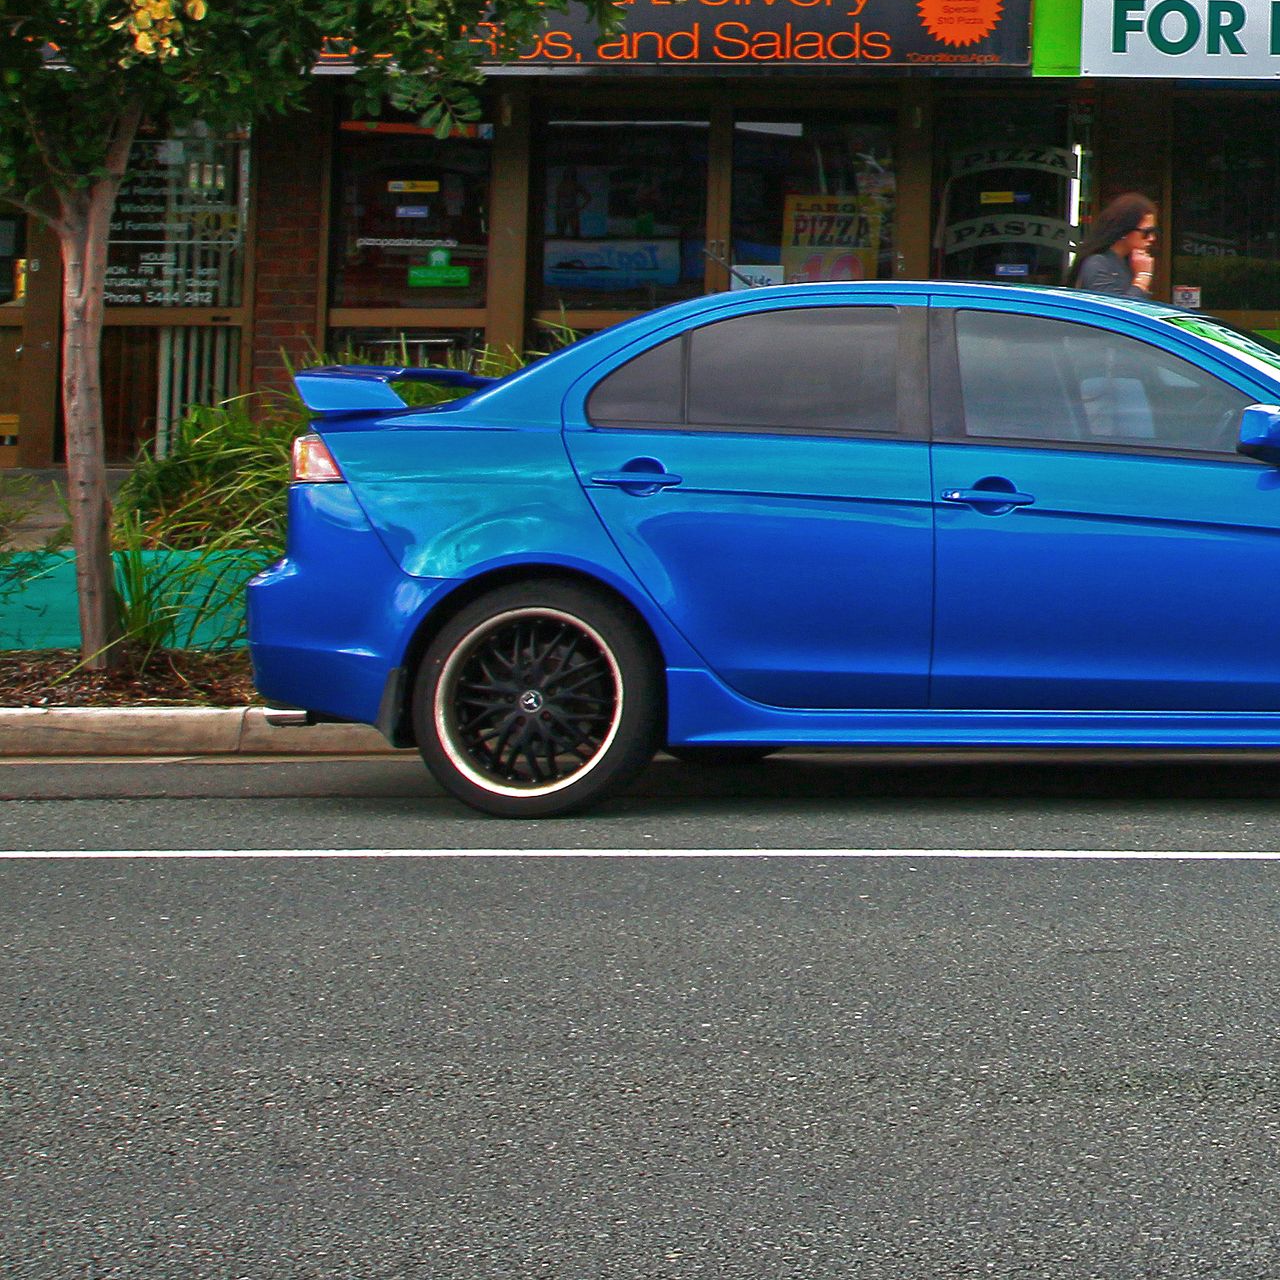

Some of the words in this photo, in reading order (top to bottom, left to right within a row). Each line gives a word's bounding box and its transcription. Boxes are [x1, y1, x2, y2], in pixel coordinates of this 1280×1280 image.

[597, 22, 701, 60] and
[712, 20, 892, 61] Salads
[791, 215, 873, 247] PIZZA
[954, 221, 1067, 244] PASTA
